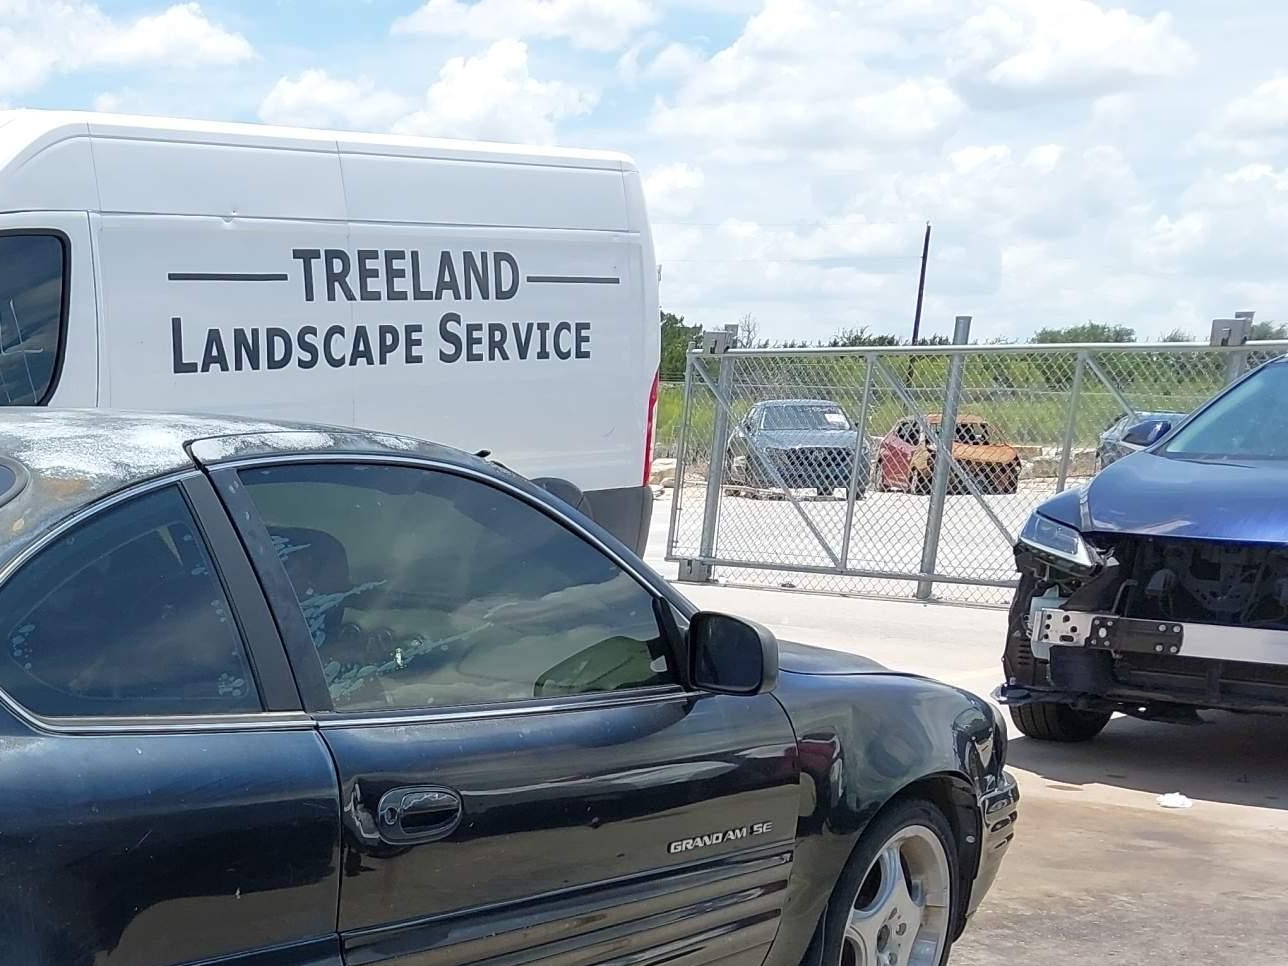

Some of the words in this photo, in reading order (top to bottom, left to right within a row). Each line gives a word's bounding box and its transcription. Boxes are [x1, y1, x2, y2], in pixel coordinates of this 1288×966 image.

[292, 248, 520, 302] TREELAND
[171, 316, 425, 374] LANDSCAPE
[438, 312, 592, 364] SERVICE
[670, 832, 723, 853] GRAND
[724, 827, 747, 841] AM
[753, 822, 773, 835] SE
